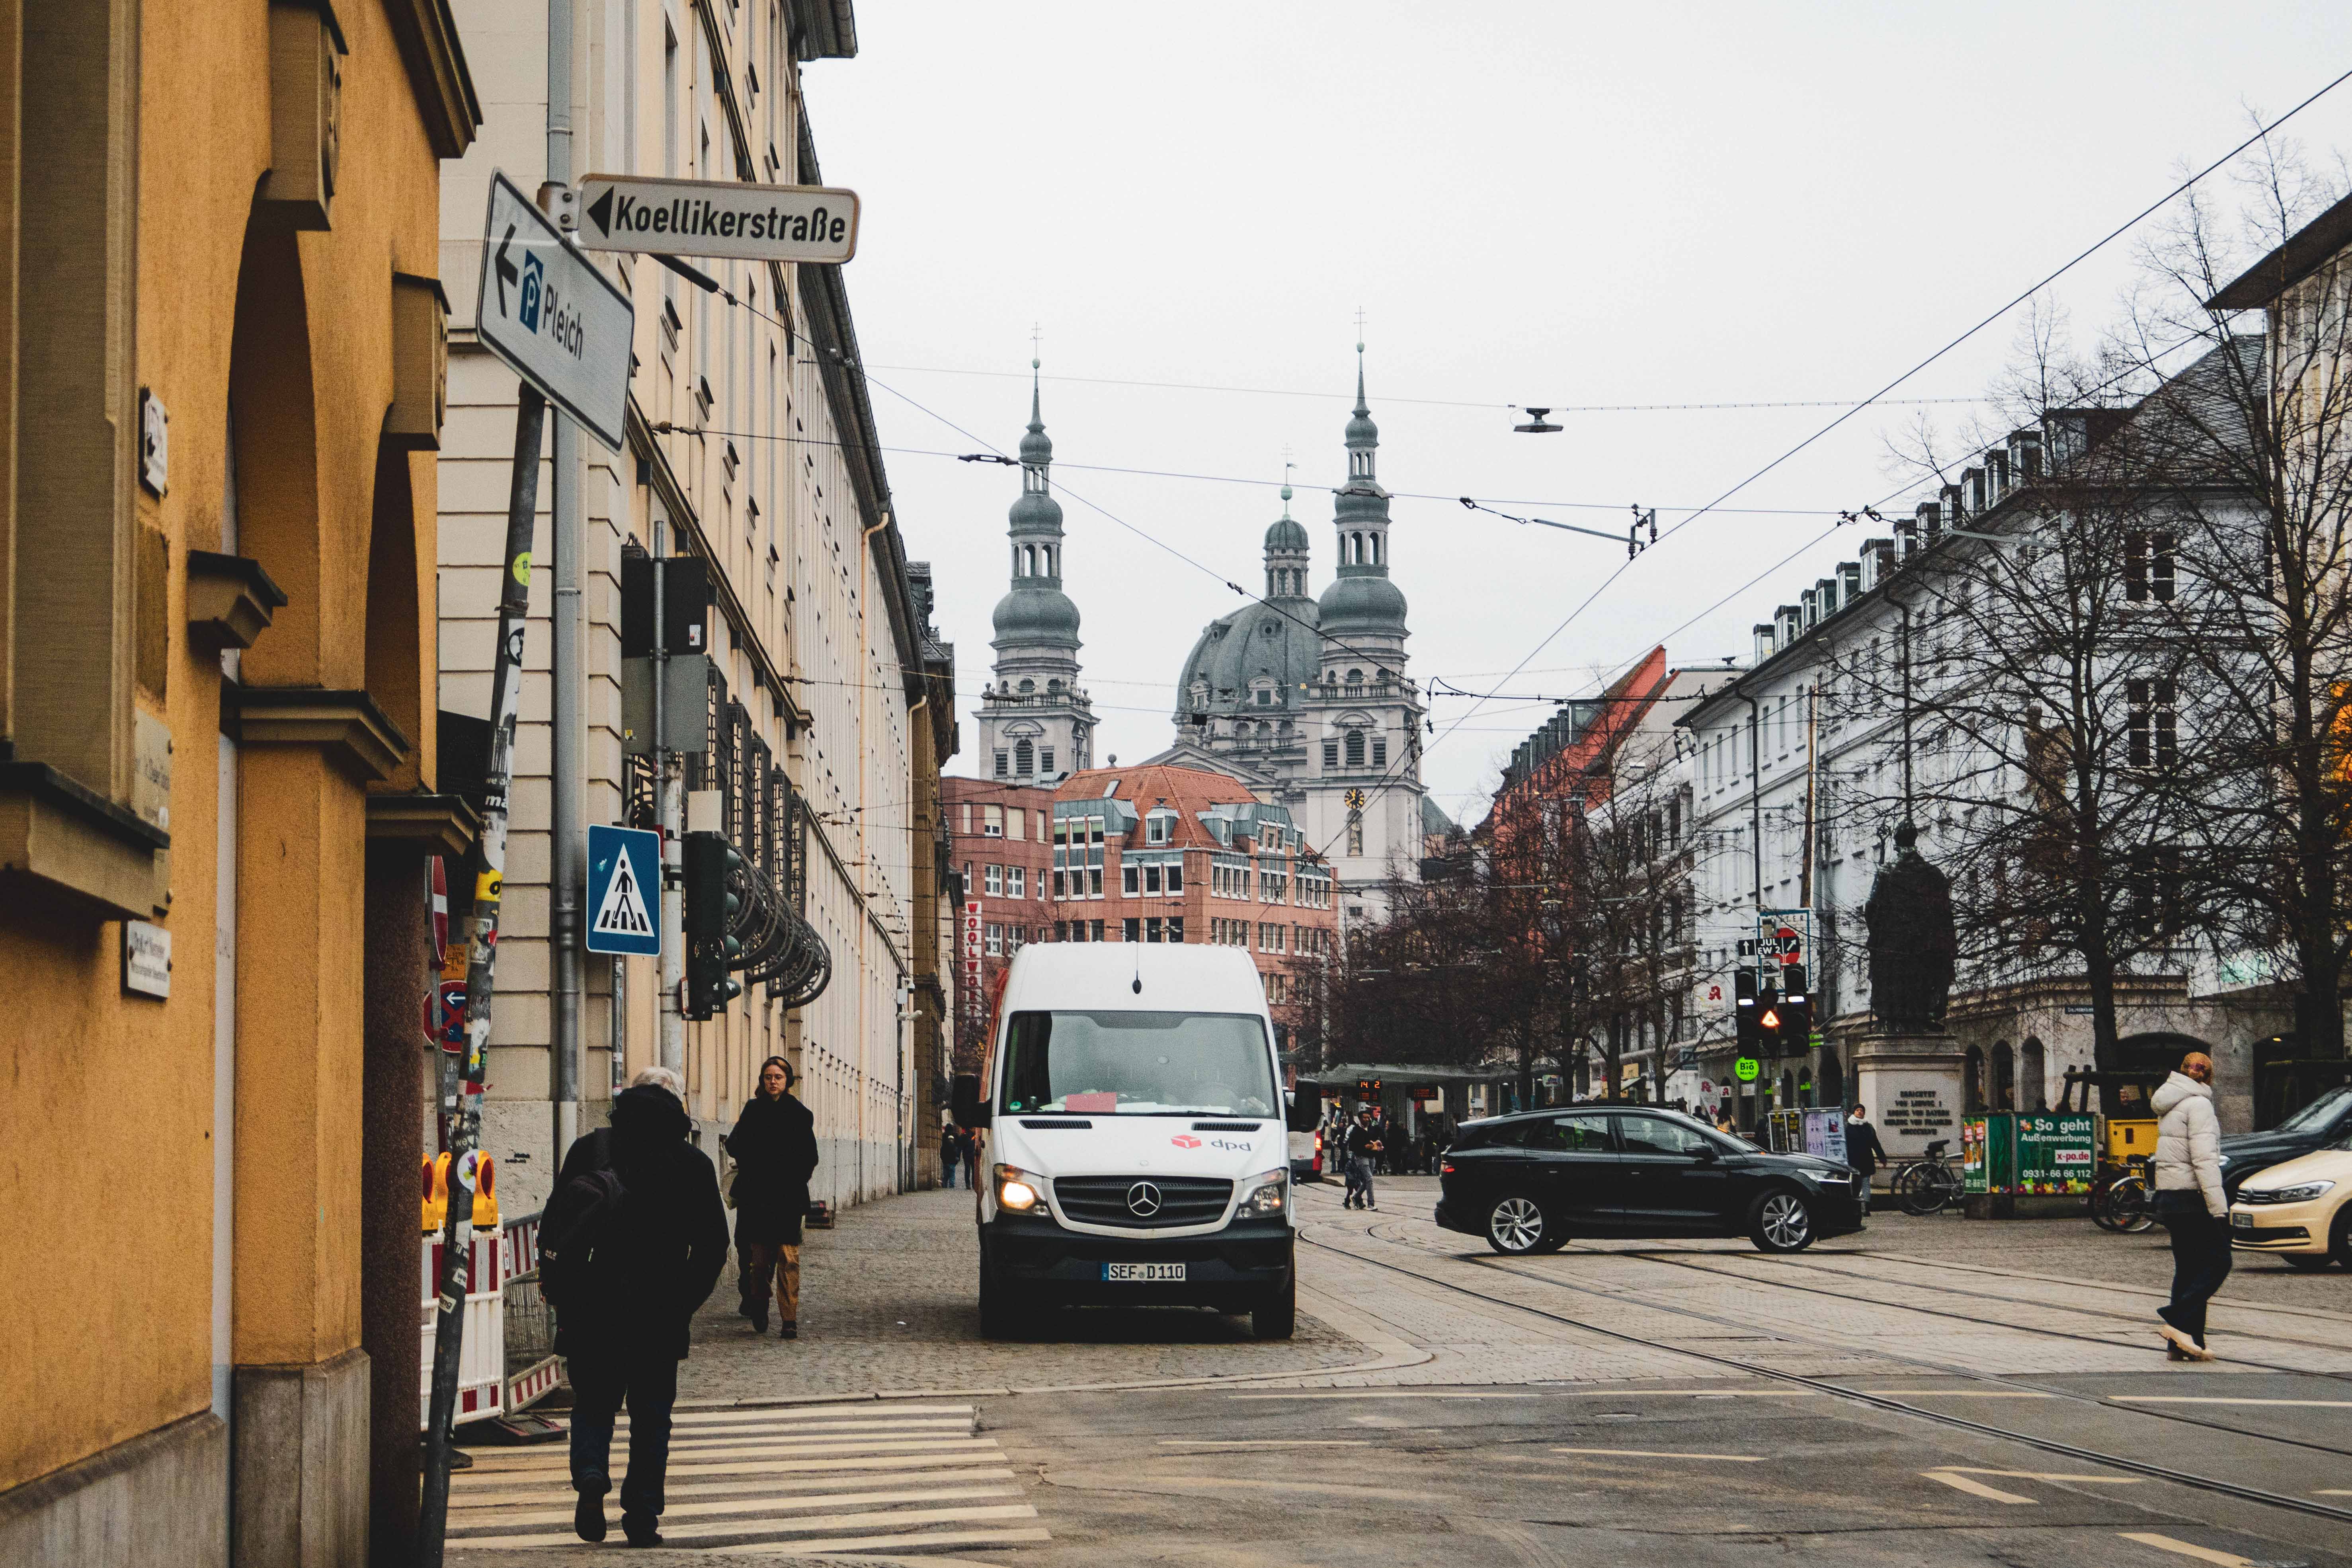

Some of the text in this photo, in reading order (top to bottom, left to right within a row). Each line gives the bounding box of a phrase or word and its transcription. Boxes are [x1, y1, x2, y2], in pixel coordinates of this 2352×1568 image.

[615, 195, 845, 243] Koellikerstraße
[543, 284, 583, 361] Pleich
[2035, 1118, 2090, 1134] So geht
[2021, 1133, 2091, 1144] Außenwerbung
[1211, 1139, 1251, 1152] dpd
[2057, 1152, 2089, 1162] x-po.de
[2077, 1170, 2091, 1178] 112
[1110, 1265, 1137, 1279] SEF
